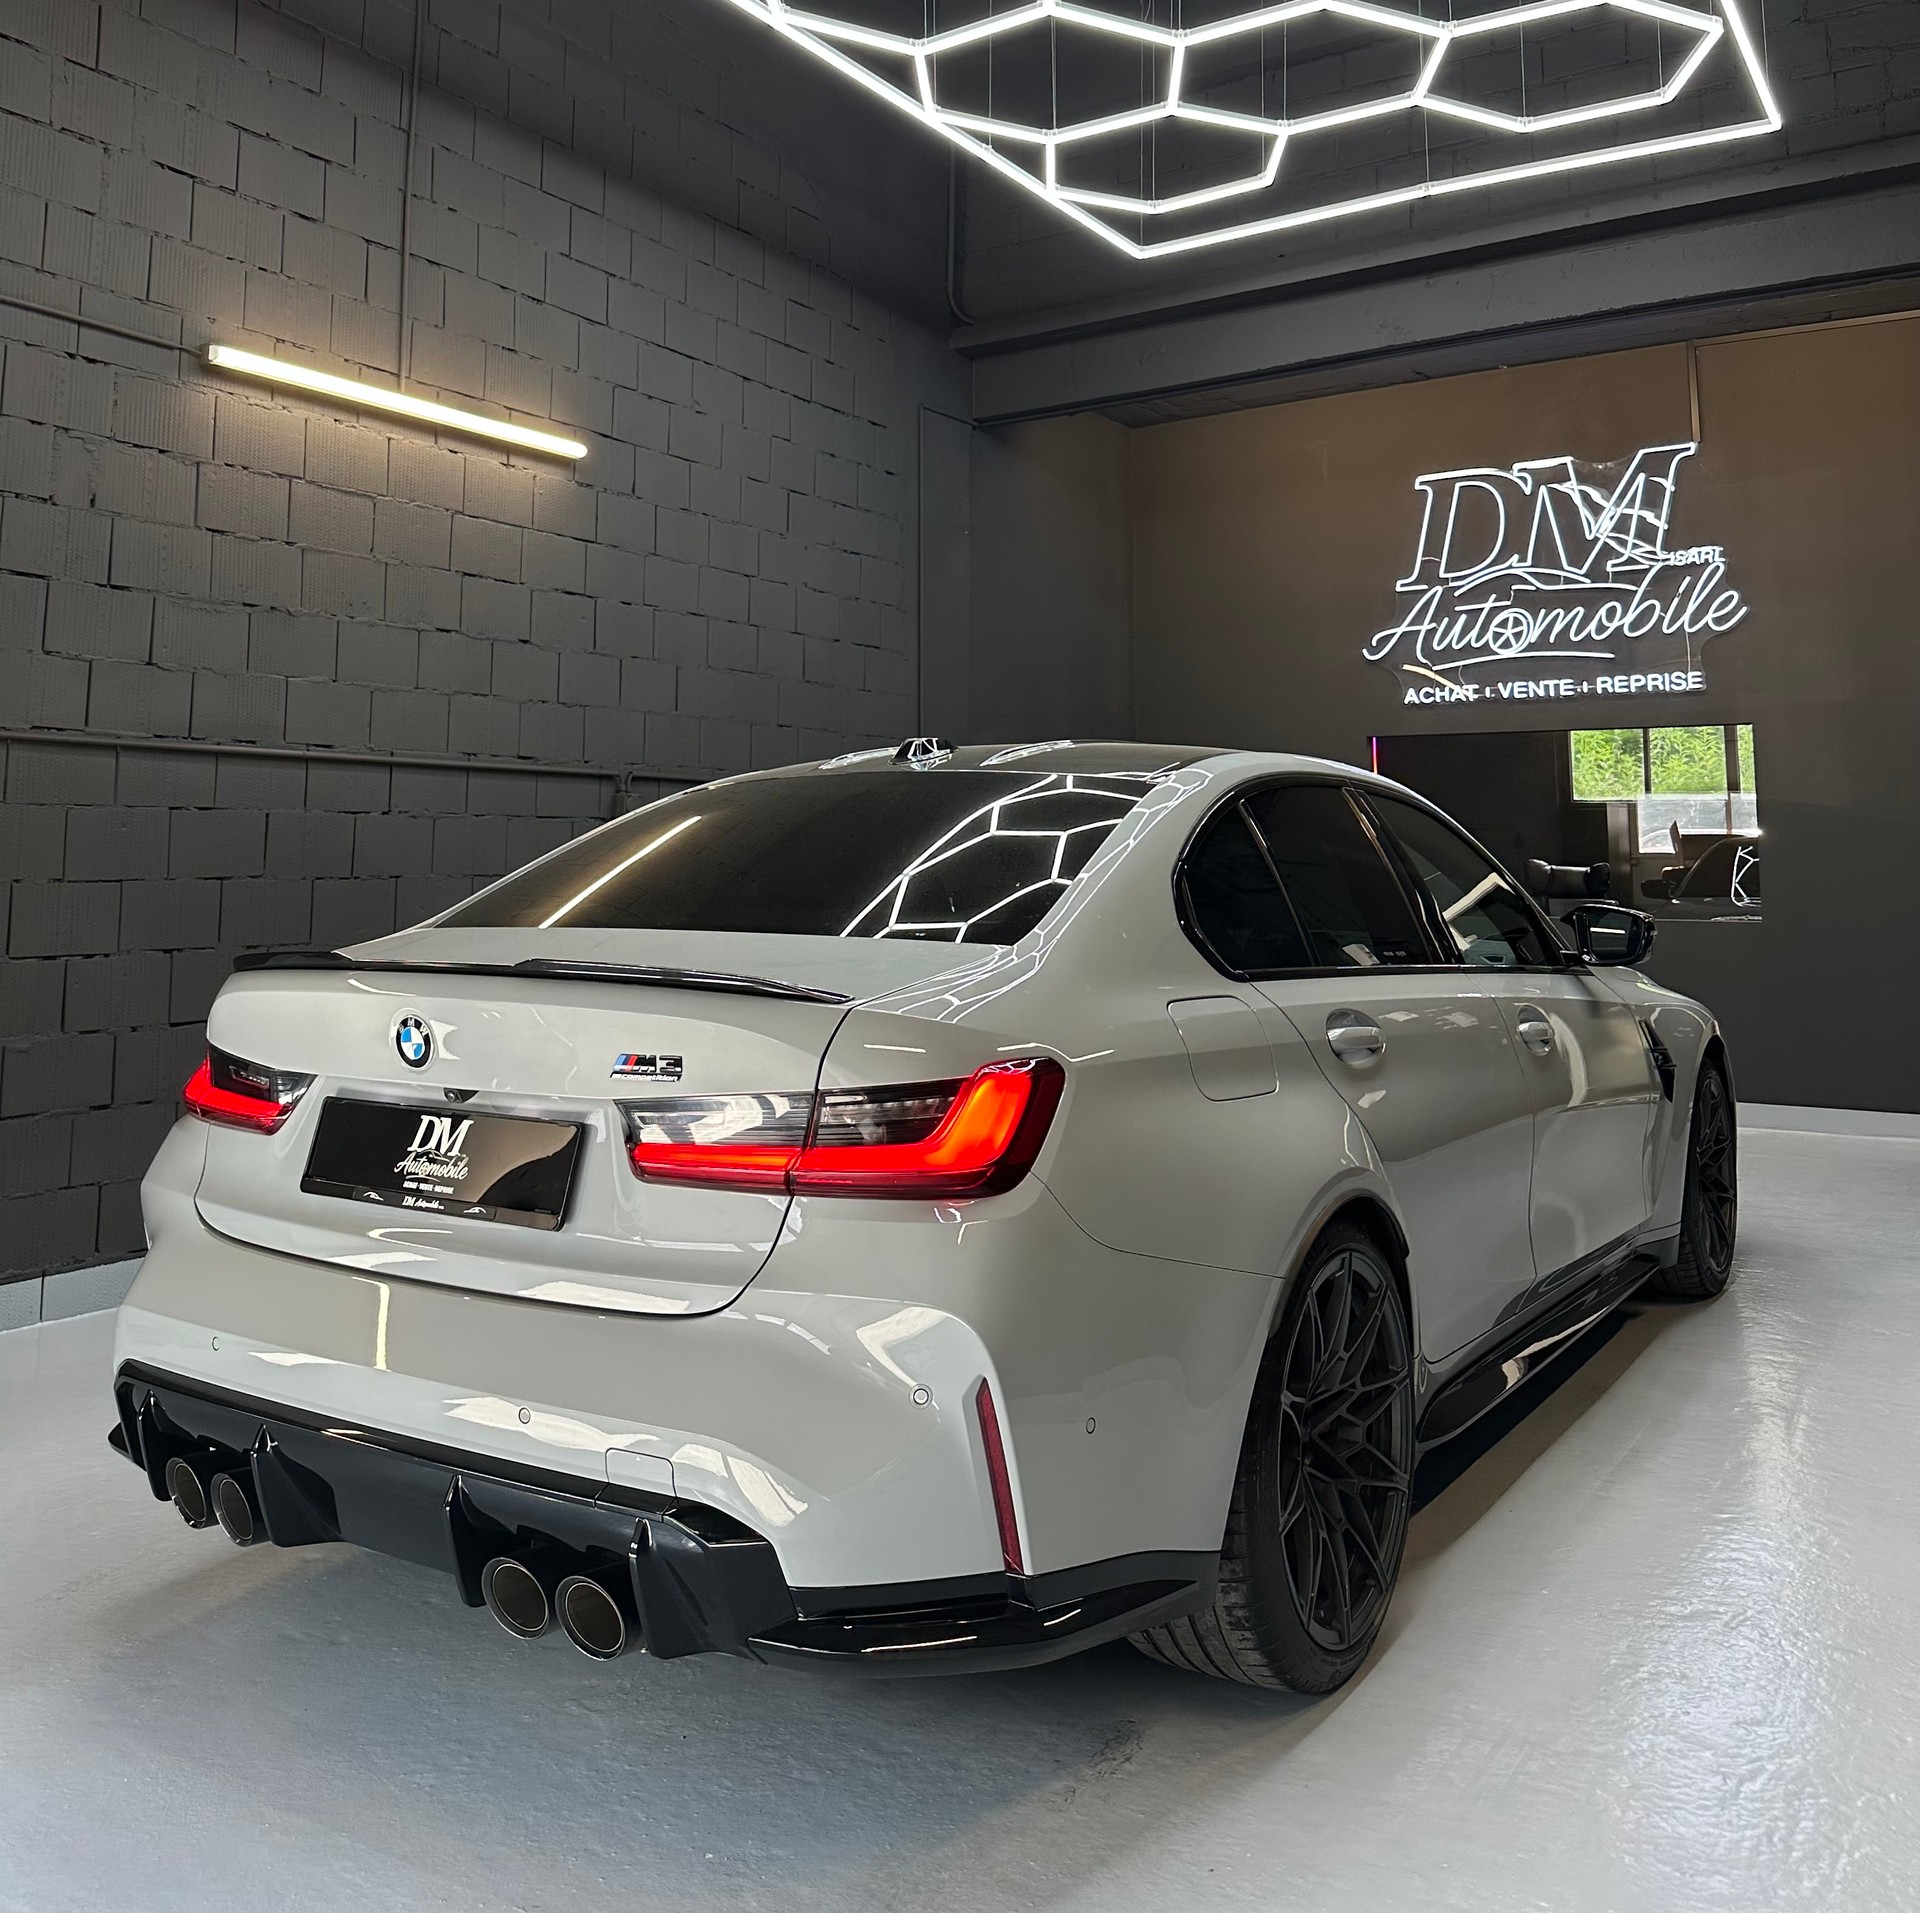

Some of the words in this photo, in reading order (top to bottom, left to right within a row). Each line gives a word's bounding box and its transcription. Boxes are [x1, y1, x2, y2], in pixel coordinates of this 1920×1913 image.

[1396, 442, 1697, 592] DM
[1362, 561, 1749, 661] Automobile
[1403, 683, 1479, 705] ACHAT
[1497, 678, 1575, 700] VENTE
[1596, 671, 1703, 694] REPRISE
[617, 1053, 683, 1073] M3
[407, 1115, 474, 1156] DM
[394, 1151, 469, 1179] Automobile
